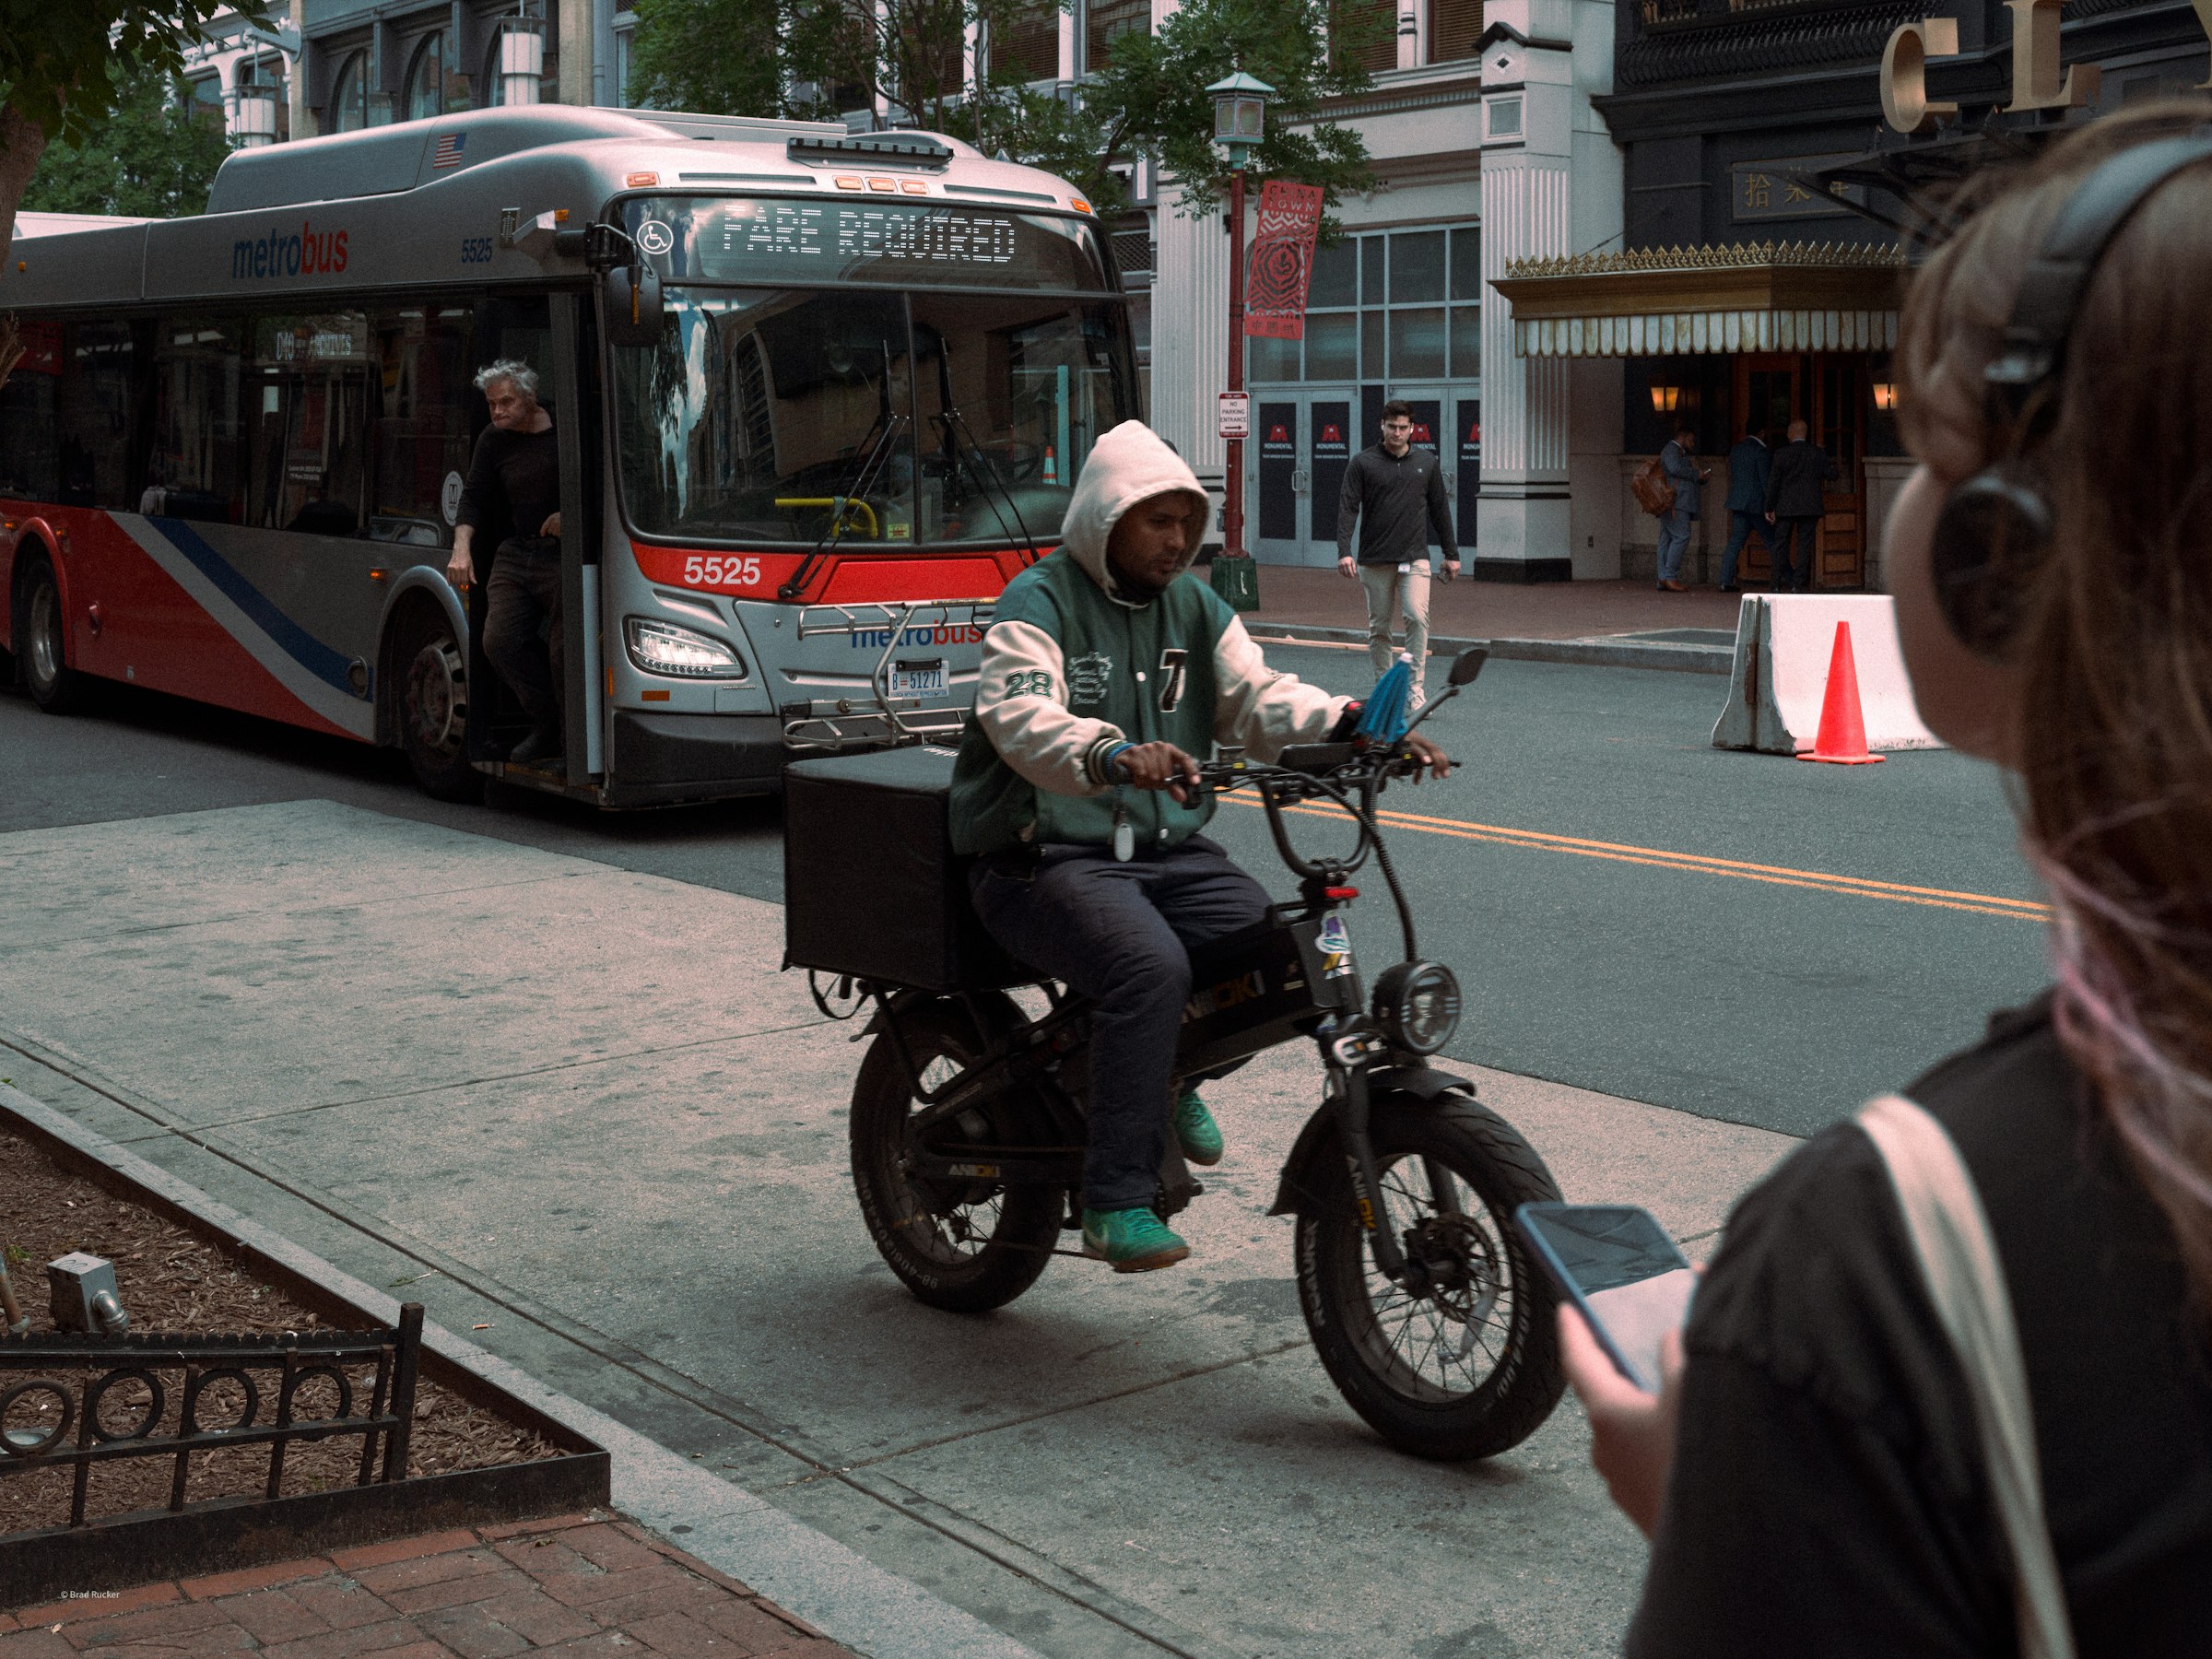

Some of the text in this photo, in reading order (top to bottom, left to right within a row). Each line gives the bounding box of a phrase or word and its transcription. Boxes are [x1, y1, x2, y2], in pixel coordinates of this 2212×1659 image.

[232, 220, 348, 279] metrobus
[461, 237, 493, 263] 5525
[724, 205, 1015, 262] FARE REQUIRED
[684, 556, 761, 585] 5525
[892, 670, 943, 690] B 51271
[1005, 668, 1053, 701] 28
[1159, 648, 1189, 713] 7
